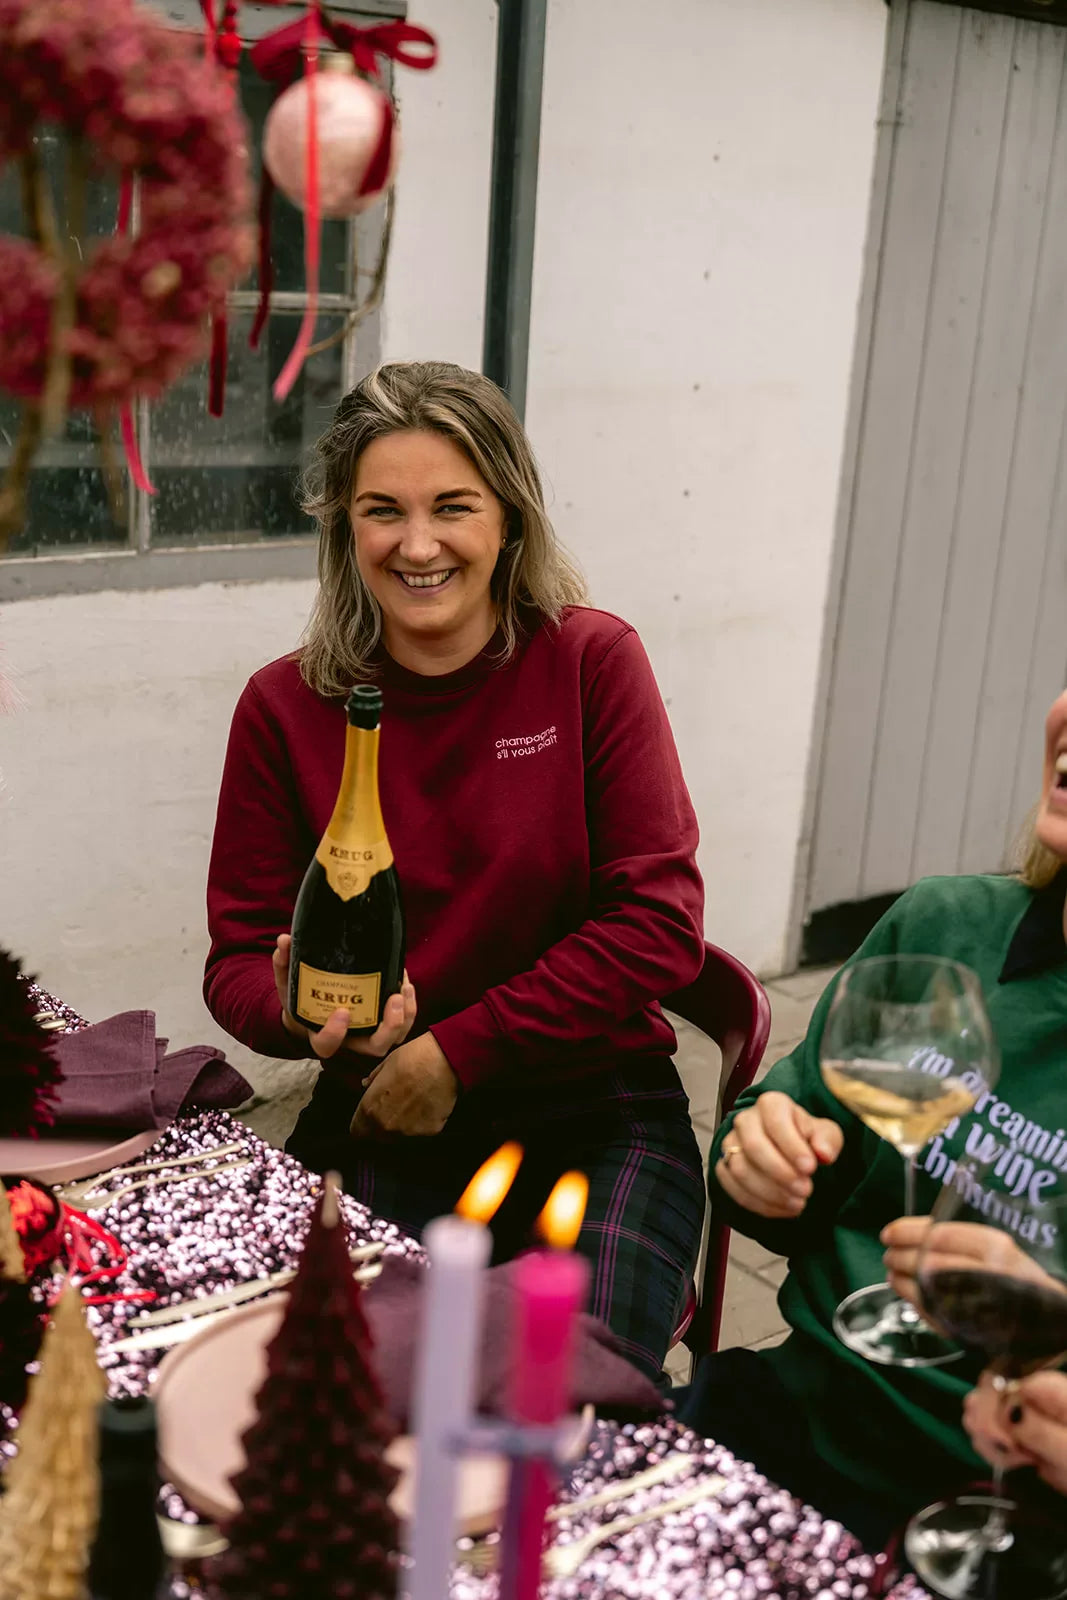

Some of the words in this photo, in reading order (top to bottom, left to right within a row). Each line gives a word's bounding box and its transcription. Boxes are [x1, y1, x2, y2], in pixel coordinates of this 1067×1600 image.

[495, 725, 556, 748] champagne
[511, 746, 536, 758] vous
[329, 846, 373, 861] KRUG
[310, 988, 363, 1005] KRUG
[911, 1135, 1058, 1248] hristmas
